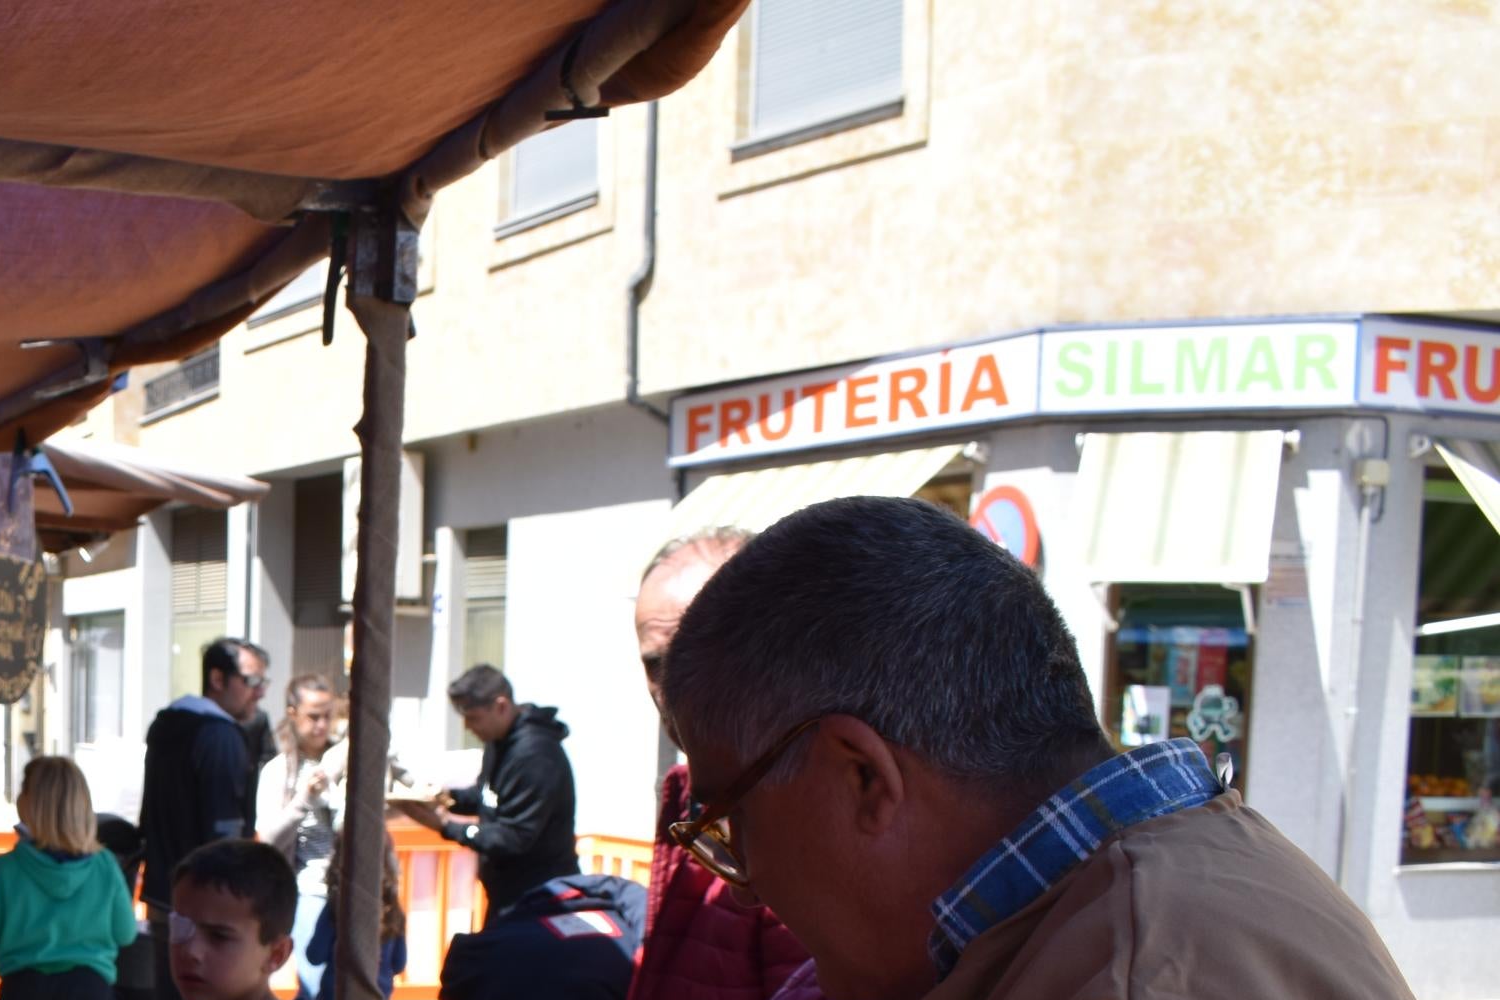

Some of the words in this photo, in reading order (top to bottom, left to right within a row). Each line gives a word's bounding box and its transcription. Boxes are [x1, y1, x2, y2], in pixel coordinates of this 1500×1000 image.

[1054, 333, 1339, 397] SILMAR
[1372, 335, 1500, 406] FRU
[685, 348, 1008, 455] FRUTERÍA
